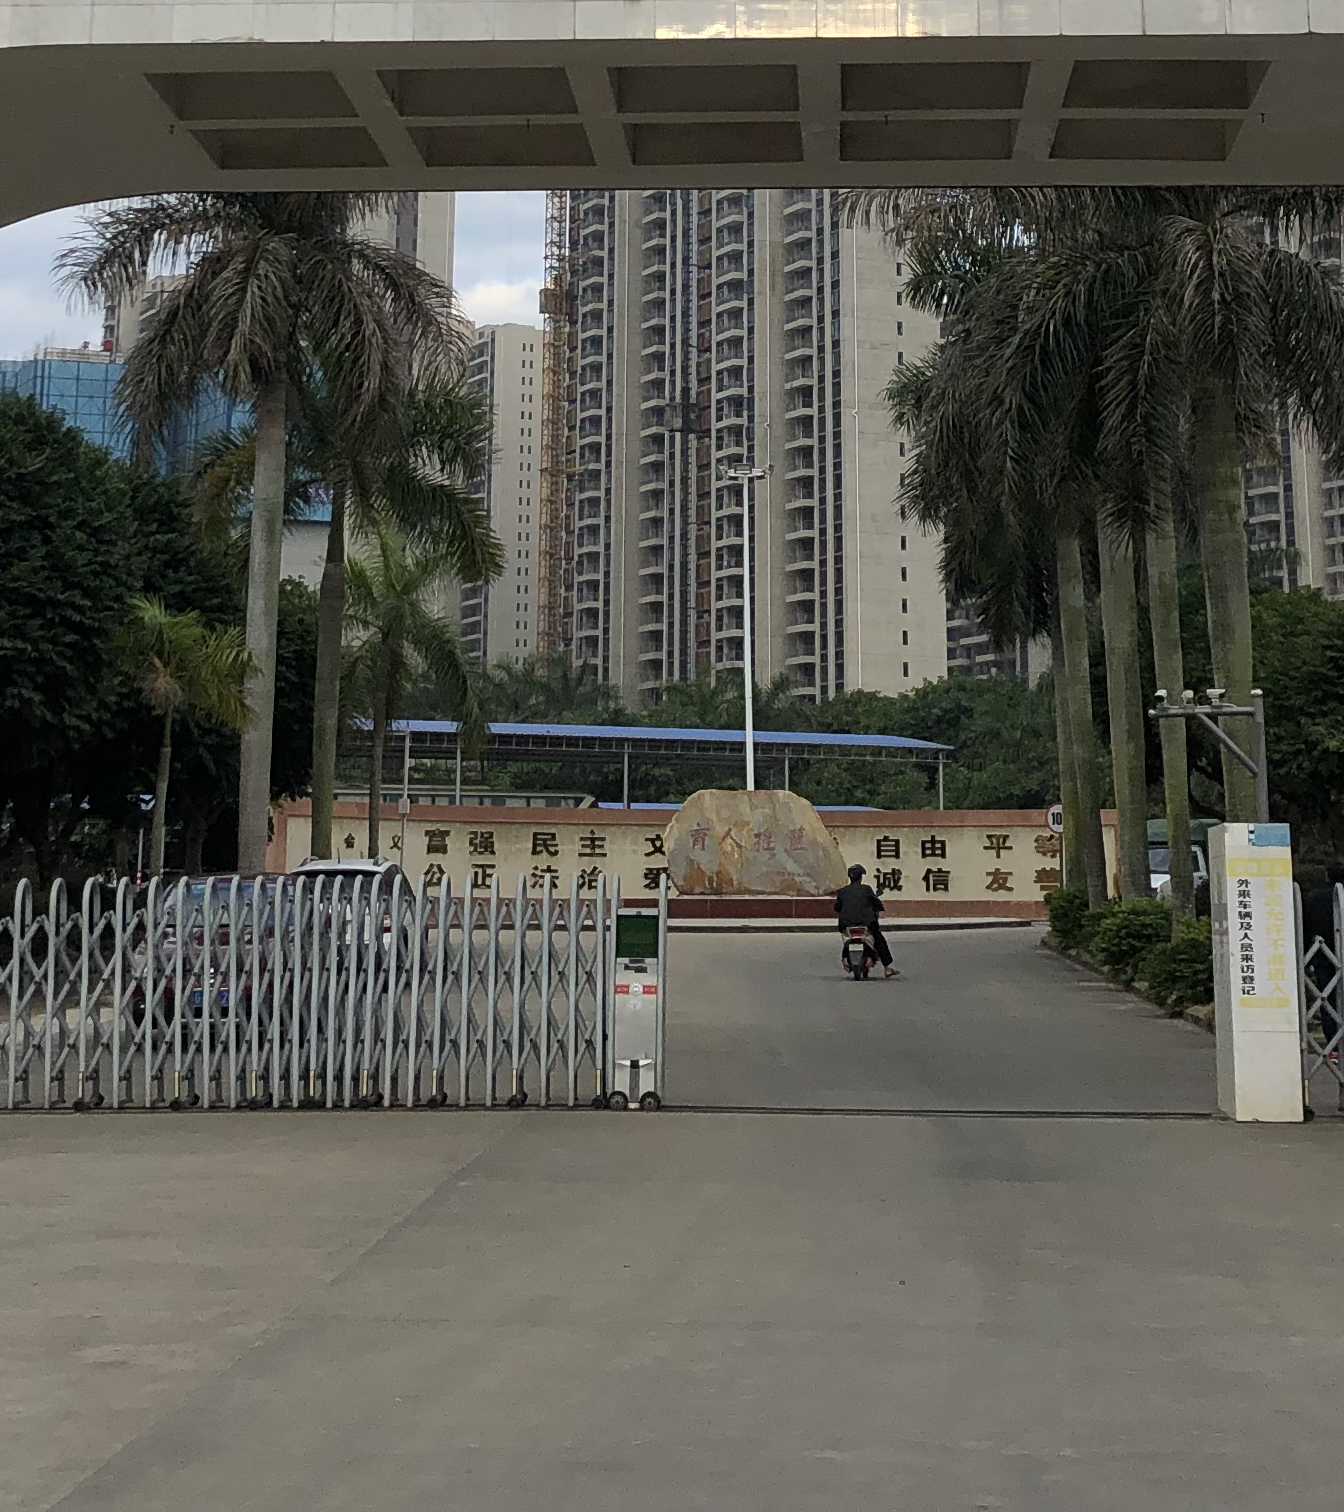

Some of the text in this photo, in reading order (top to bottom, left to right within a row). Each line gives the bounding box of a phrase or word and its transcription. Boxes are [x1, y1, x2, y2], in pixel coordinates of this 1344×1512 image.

[1051, 812, 1063, 825] 10
[424, 828, 497, 856] 富强
[531, 829, 607, 857] 民主
[876, 835, 947, 859] 自由
[983, 834, 1060, 859] 平等
[423, 863, 496, 889] 公正
[530, 865, 605, 890] 法治
[873, 867, 951, 892] 诚信
[1237, 879, 1256, 995] 外来车辆及人员来访登记
